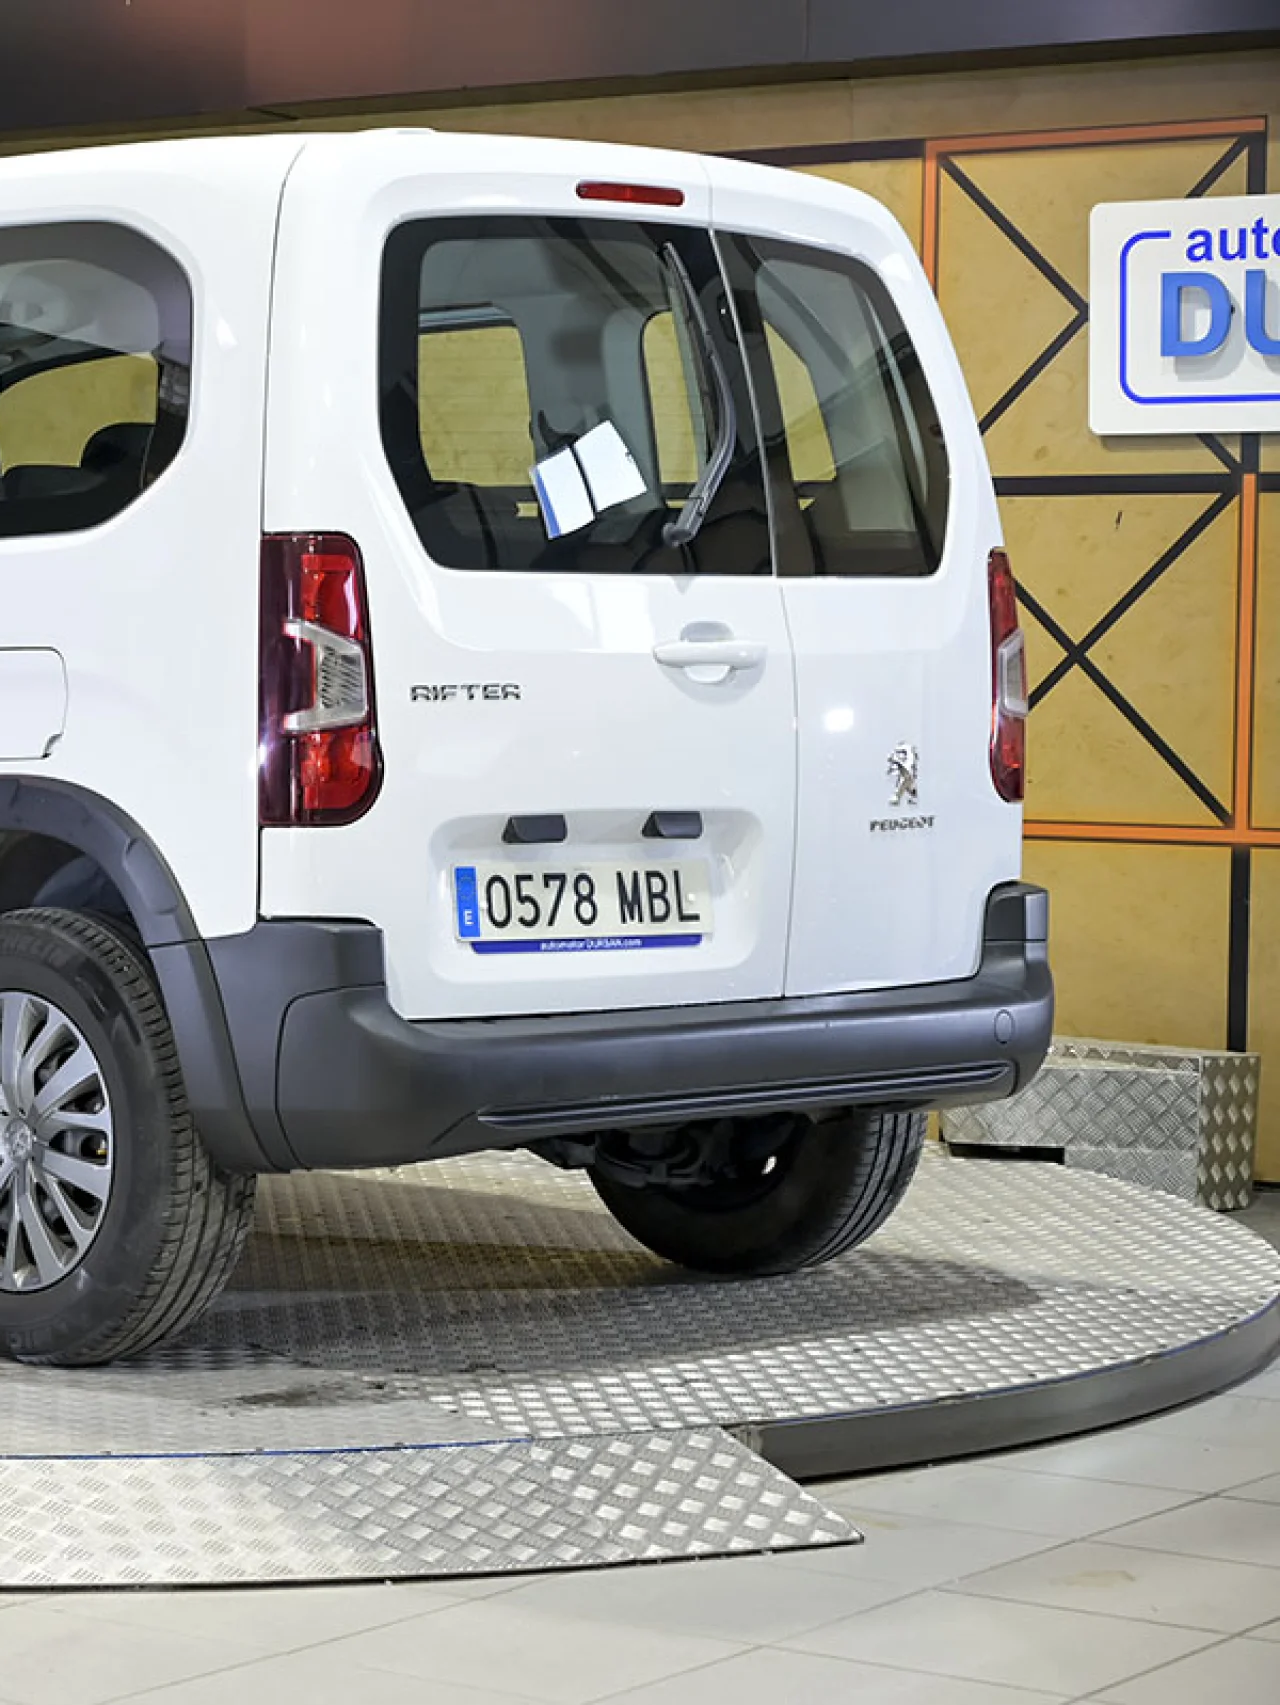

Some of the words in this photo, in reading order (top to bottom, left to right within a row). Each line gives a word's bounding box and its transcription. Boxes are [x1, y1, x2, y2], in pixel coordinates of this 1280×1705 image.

[410, 683, 522, 702] RIFTER
[485, 872, 598, 929] 0578
[616, 869, 701, 925] MBL
[463, 910, 475, 926] E
